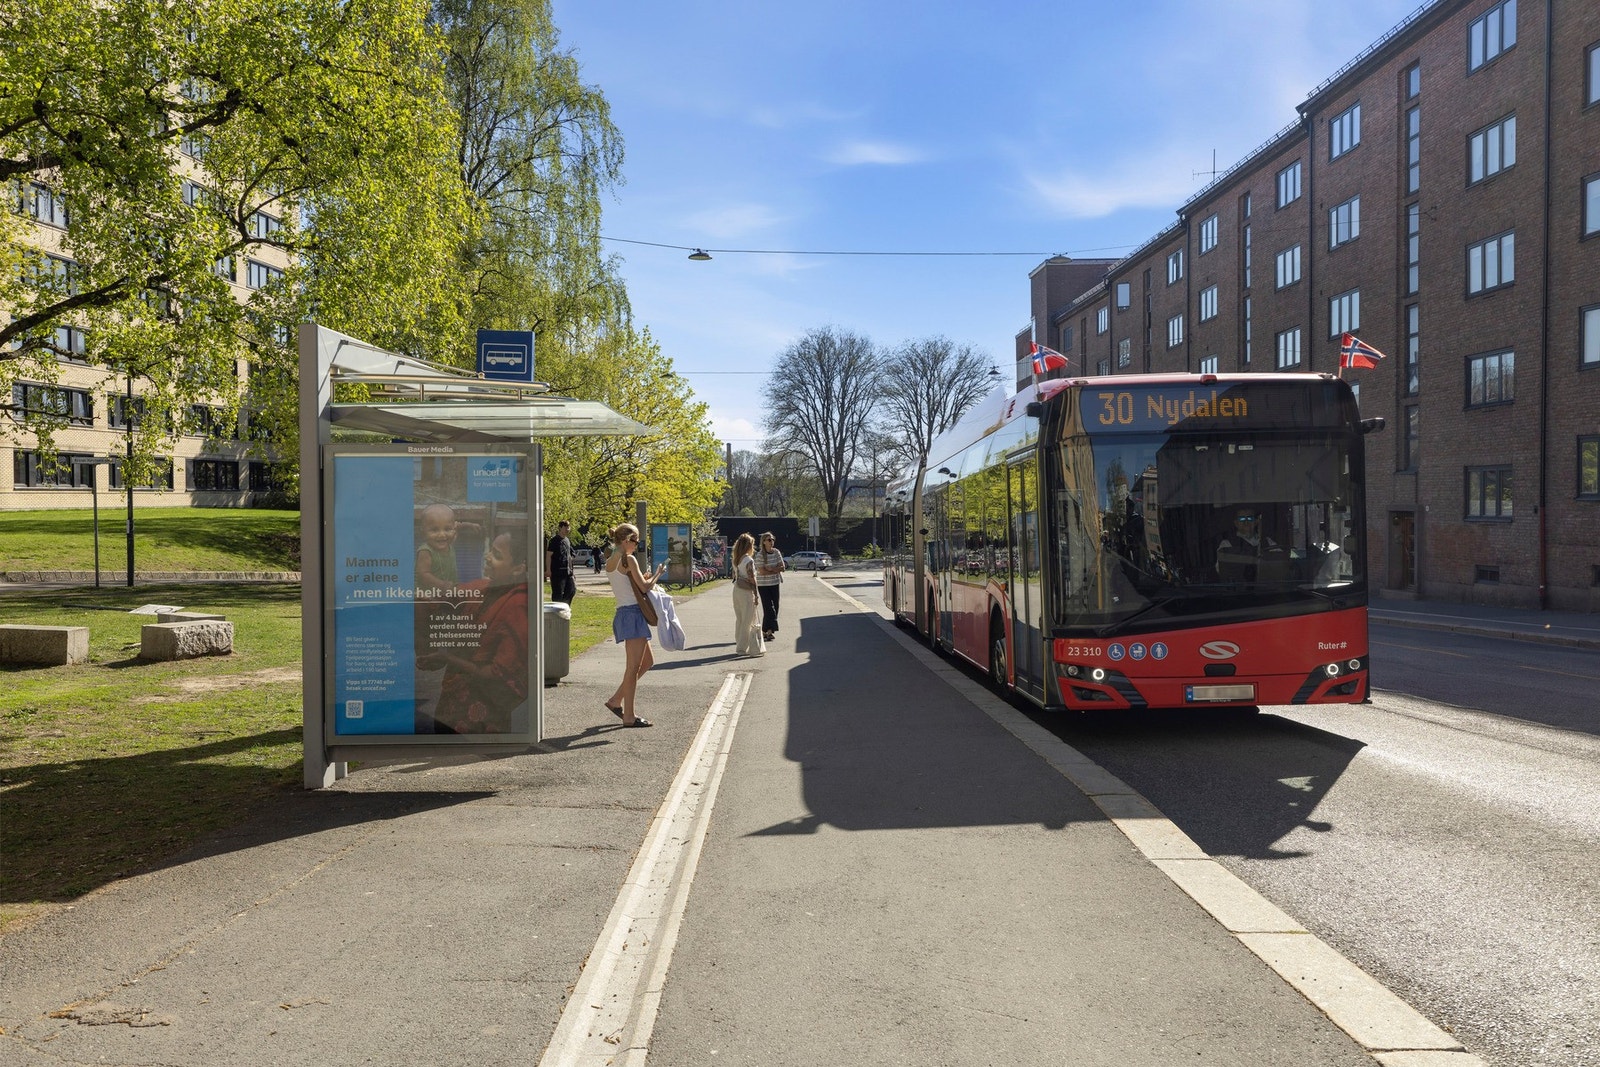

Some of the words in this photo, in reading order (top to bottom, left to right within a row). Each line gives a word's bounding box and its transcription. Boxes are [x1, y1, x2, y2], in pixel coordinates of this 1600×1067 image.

[1098, 392, 1134, 425] 30
[1147, 390, 1248, 425] Nydalen
[473, 467, 500, 477] unicef
[345, 557, 399, 567] Mamma
[345, 574, 359, 583] er
[363, 572, 399, 583] alene
[353, 588, 382, 598] men
[385, 586, 413, 598] ikke
[416, 586, 441, 598] helt
[446, 586, 484, 598] alene.
[478, 622, 488, 631] på
[1318, 641, 1348, 650] Ruter#
[1067, 646, 1080, 657] 23
[1082, 646, 1102, 657] 310
